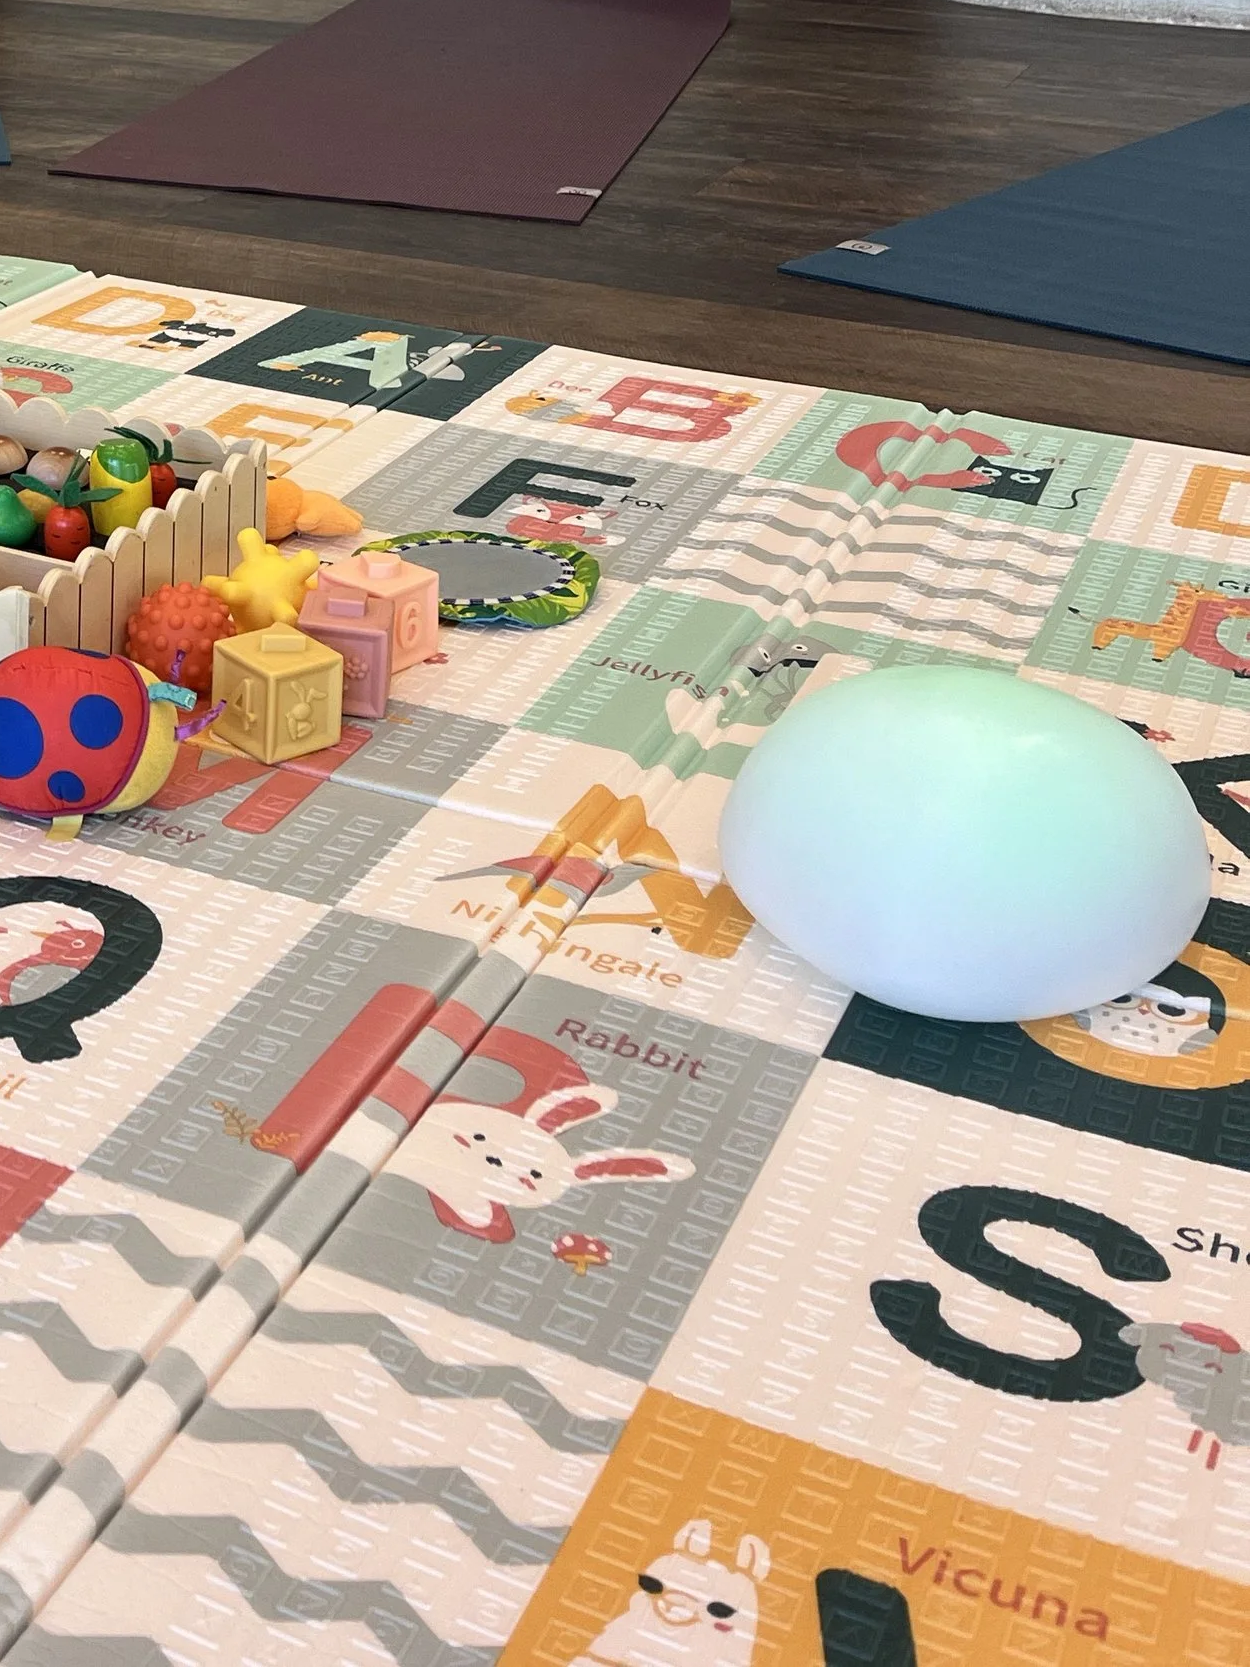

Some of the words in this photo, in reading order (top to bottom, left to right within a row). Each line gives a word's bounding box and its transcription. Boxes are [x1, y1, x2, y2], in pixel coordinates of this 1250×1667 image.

[6, 355, 75, 374] Giraffe
[620, 494, 669, 511] Fox
[399, 600, 424, 651] 6
[590, 656, 729, 699] Jellyfis
[555, 1017, 709, 1081] Rabbit
[869, 1184, 1172, 1402] S
[899, 1536, 1111, 1642] Vicuna
